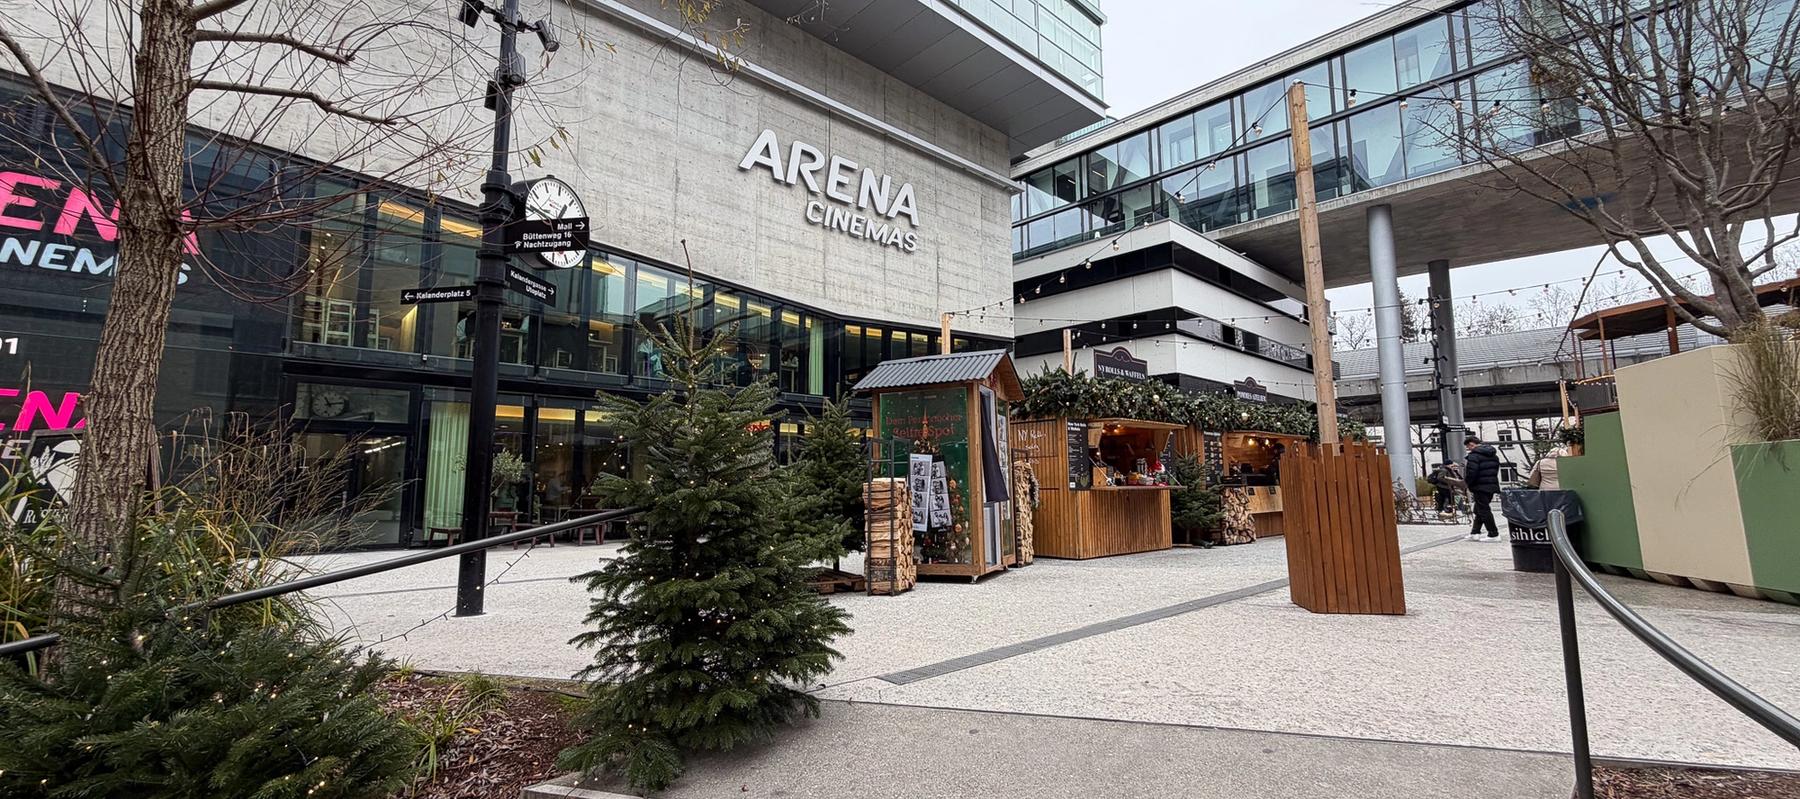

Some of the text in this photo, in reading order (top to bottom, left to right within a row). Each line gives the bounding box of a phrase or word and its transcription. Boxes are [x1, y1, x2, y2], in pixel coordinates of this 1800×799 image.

[738, 129, 920, 228] ARENA
[557, 222, 573, 231] Mall
[806, 200, 918, 253] CINEMAS
[523, 232, 562, 241] Büttenweg
[523, 240, 572, 250] Nachtzugang
[510, 269, 547, 293] Kalandergasse
[416, 290, 465, 300] Kalanderplatz
[525, 284, 547, 300] Utoplatz
[1105, 366, 1120, 375] ROLLS
